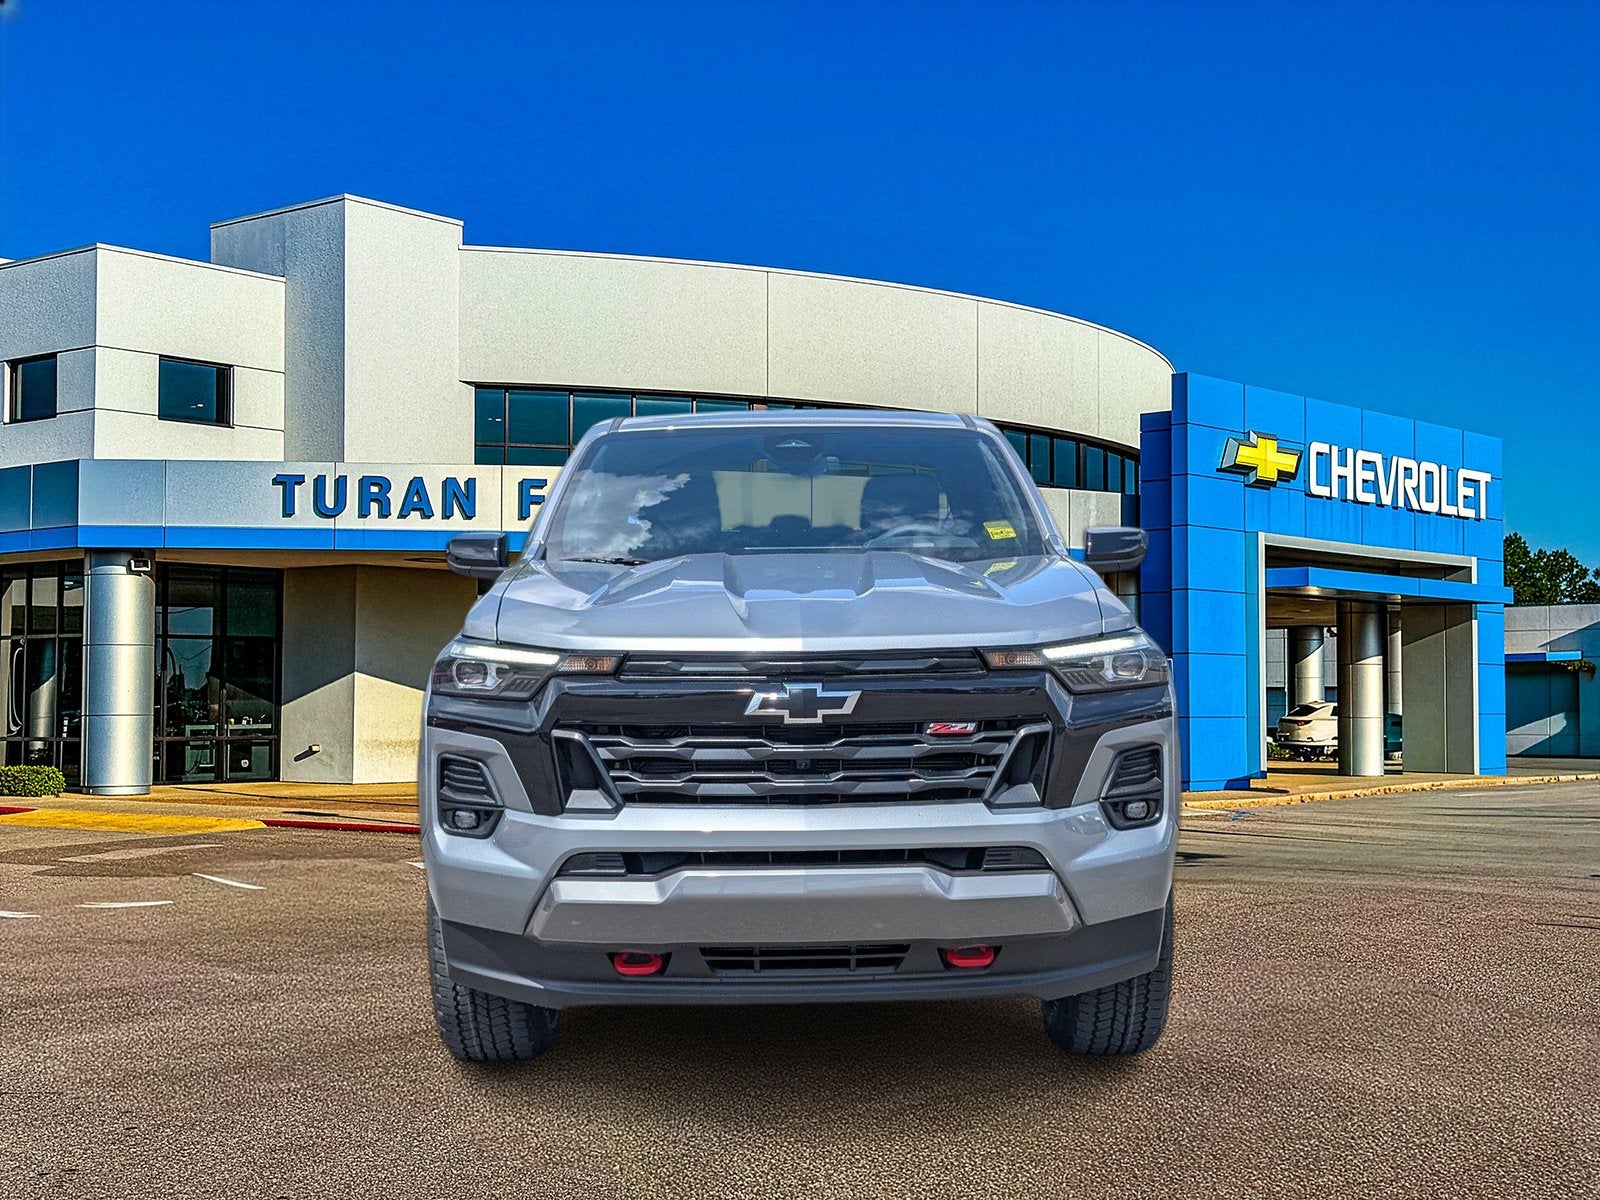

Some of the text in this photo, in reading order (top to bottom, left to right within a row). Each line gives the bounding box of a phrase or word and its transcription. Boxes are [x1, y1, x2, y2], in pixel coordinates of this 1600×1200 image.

[272, 474, 476, 520] TURAN
[1308, 441, 1492, 520] CHEVROLET
[926, 722, 977, 734] Z71
